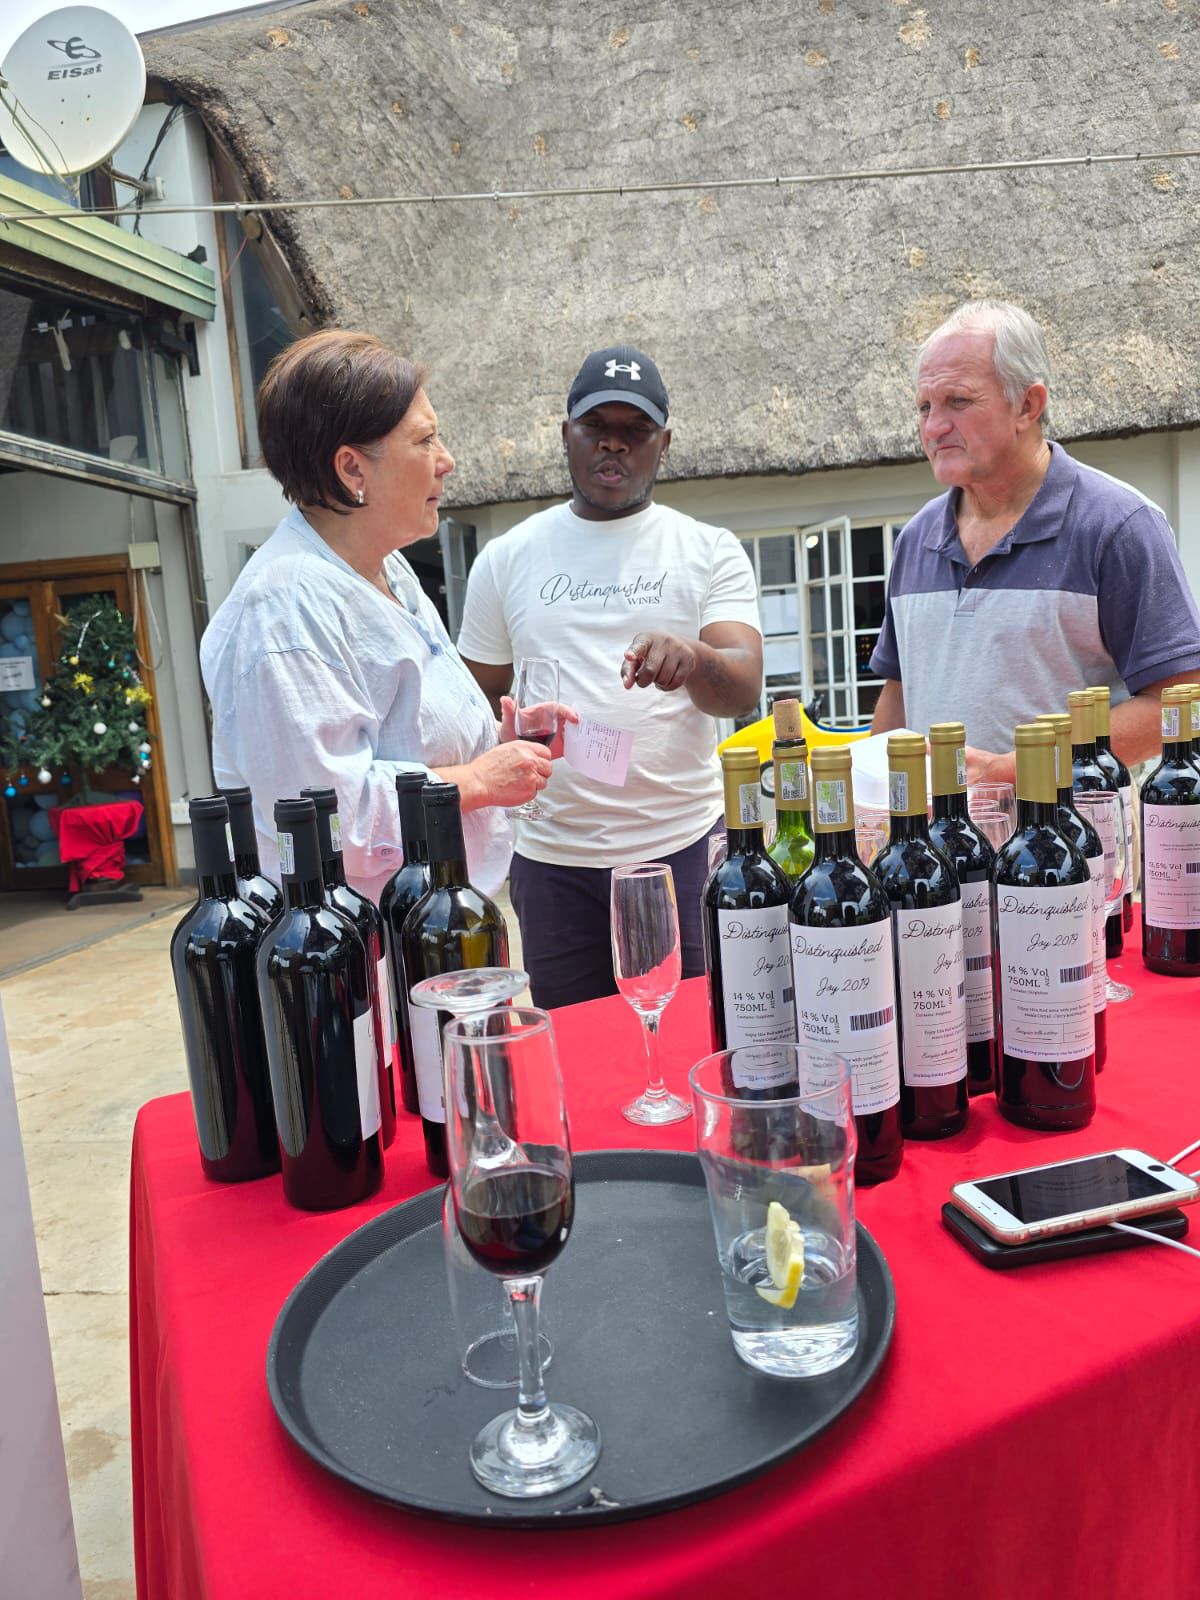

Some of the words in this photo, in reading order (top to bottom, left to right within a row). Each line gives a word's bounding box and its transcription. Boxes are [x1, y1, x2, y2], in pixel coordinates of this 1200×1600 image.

[540, 571, 668, 607] Distinguished
[627, 596, 660, 605] WINES
[1000, 893, 1089, 920] Distinguished
[792, 935, 883, 963] Distinguished
[1026, 933, 1050, 952] Joy
[1053, 933, 1079, 947] 2019
[753, 956, 775, 976] Joy
[934, 953, 952, 974] Joy
[1008, 965, 1016, 974] 14
[1019, 966, 1028, 975] %
[1031, 968, 1049, 977] Vol
[816, 977, 840, 996] Joy
[841, 977, 870, 991] 2019
[1008, 976, 1041, 988] 750ML
[758, 990, 775, 1000] Vol
[912, 990, 923, 999] 14
[926, 990, 936, 999] %
[734, 1003, 767, 1012] 750ML
[913, 1000, 946, 1010] 750ML
[801, 1010, 808, 1019] 14
[810, 1012, 819, 1022] %
[821, 1014, 839, 1024] Vol
[802, 1021, 831, 1036] 750ML
